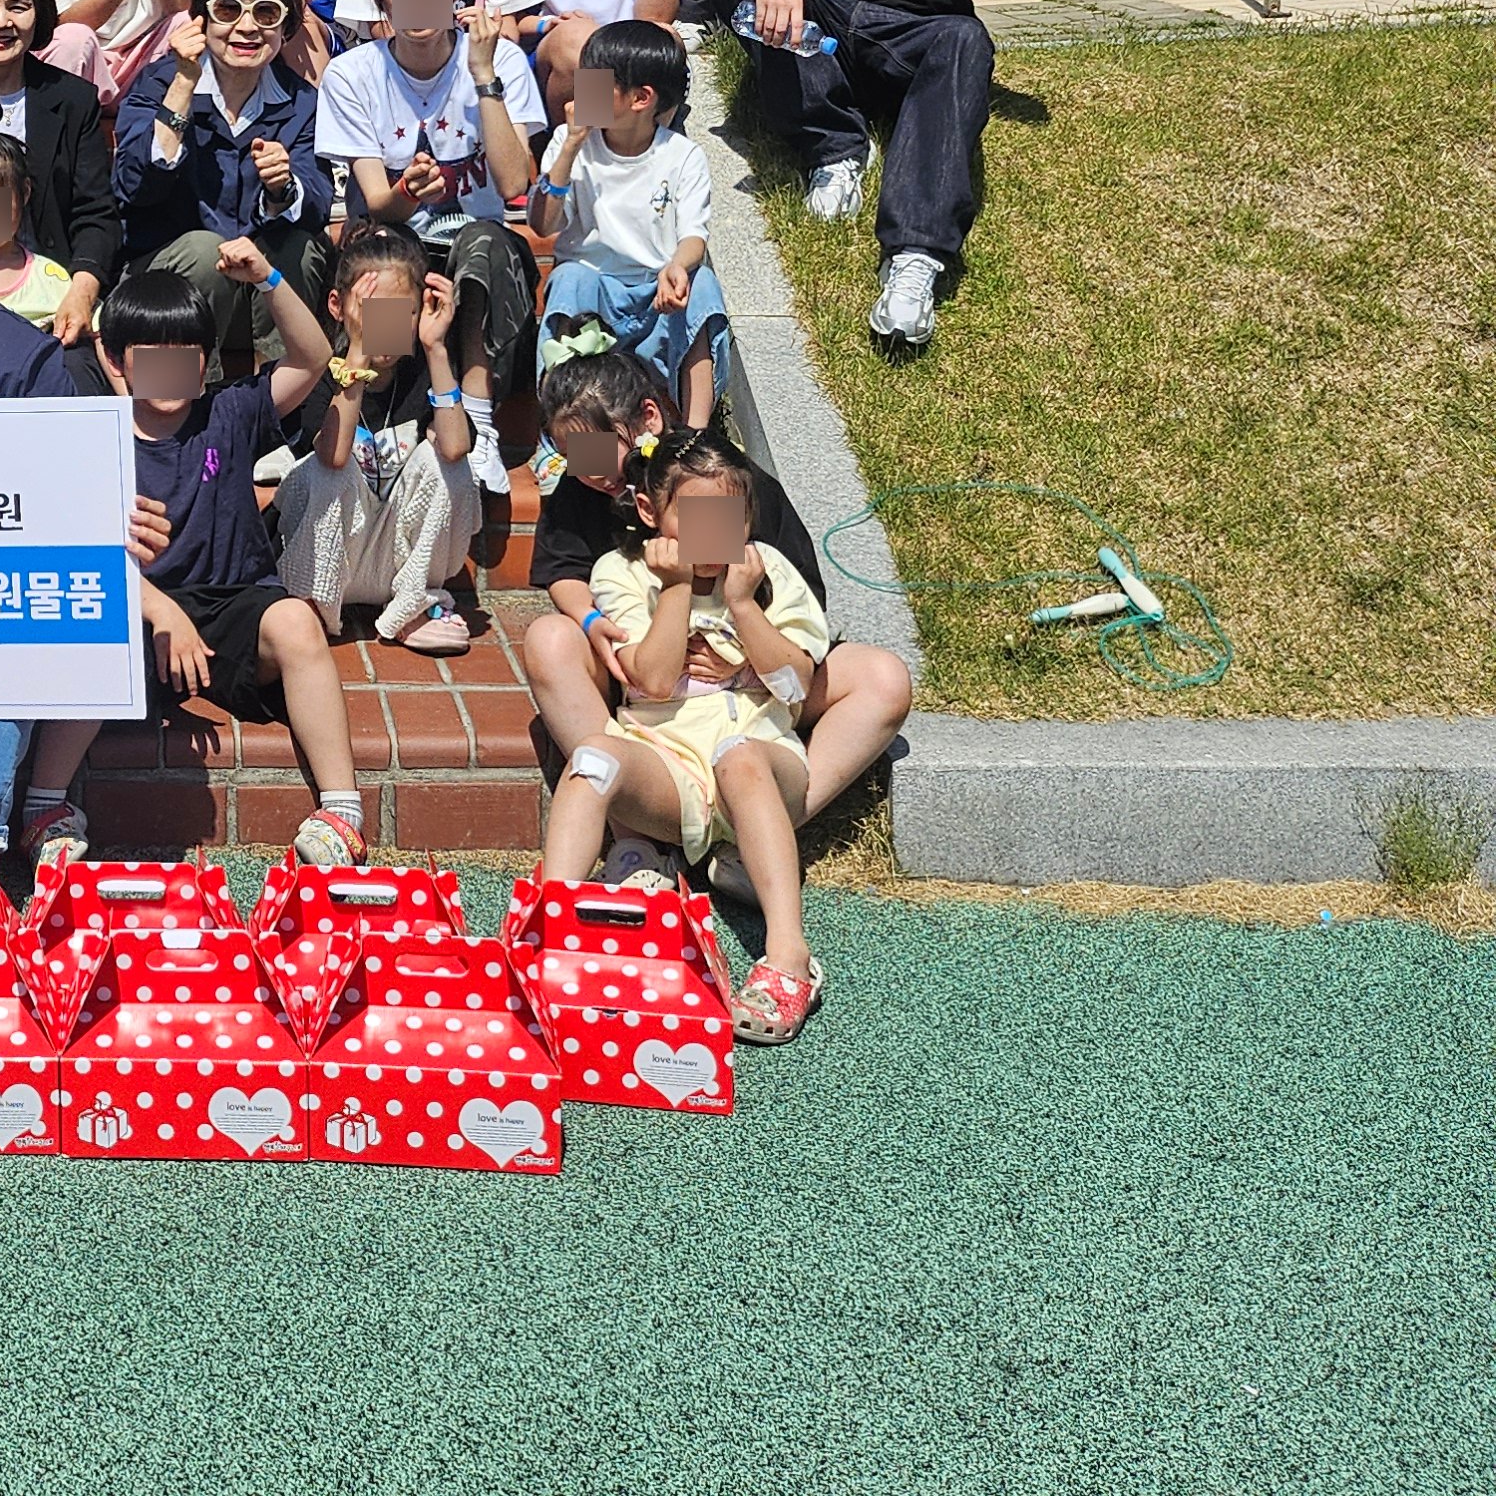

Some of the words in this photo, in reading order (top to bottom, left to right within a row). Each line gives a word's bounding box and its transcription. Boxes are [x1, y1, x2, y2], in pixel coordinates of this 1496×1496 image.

[651, 1053, 671, 1064] love
[226, 1101, 246, 1111] love
[477, 1112, 497, 1123] love
